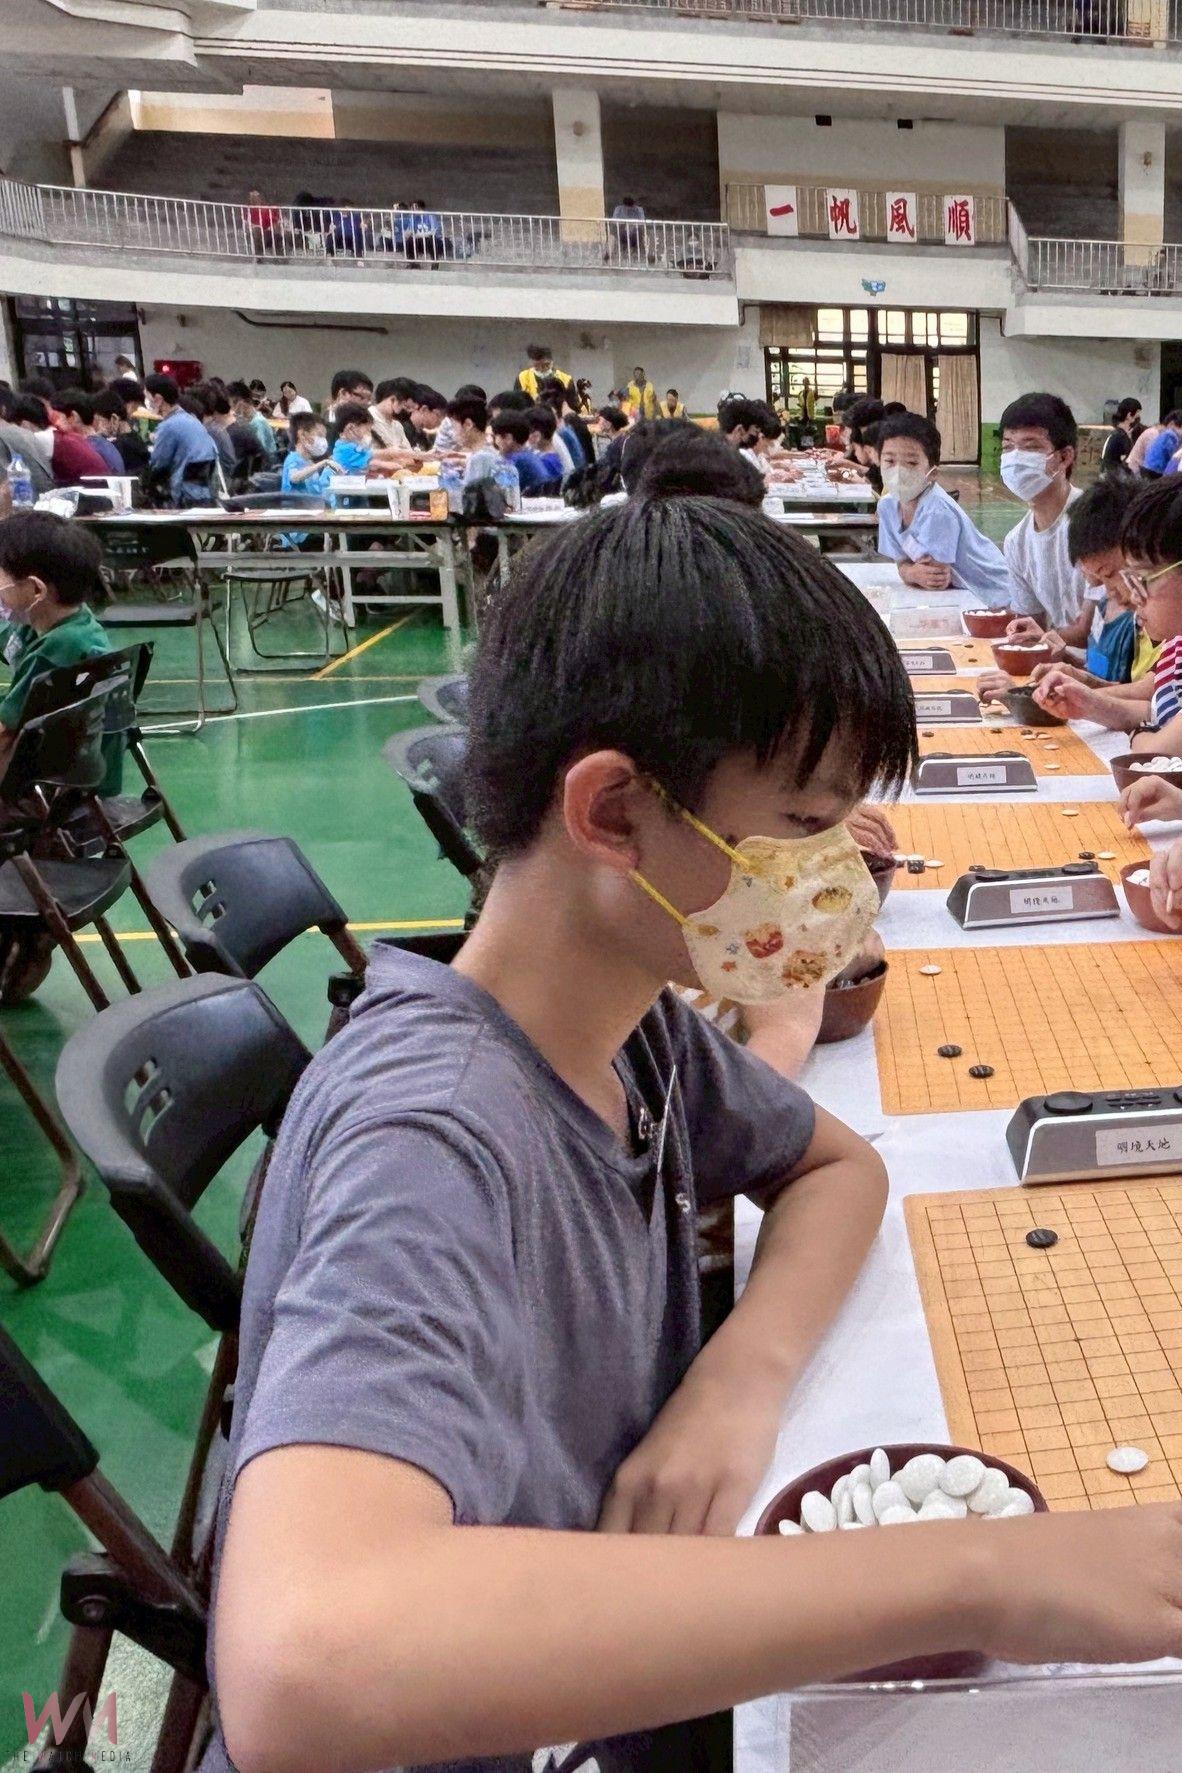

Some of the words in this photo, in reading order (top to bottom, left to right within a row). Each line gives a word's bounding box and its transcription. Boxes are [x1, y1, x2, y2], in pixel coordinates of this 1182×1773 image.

[769, 194, 973, 242] 一帆風順
[1117, 1137, 1171, 1154] 明境天地
